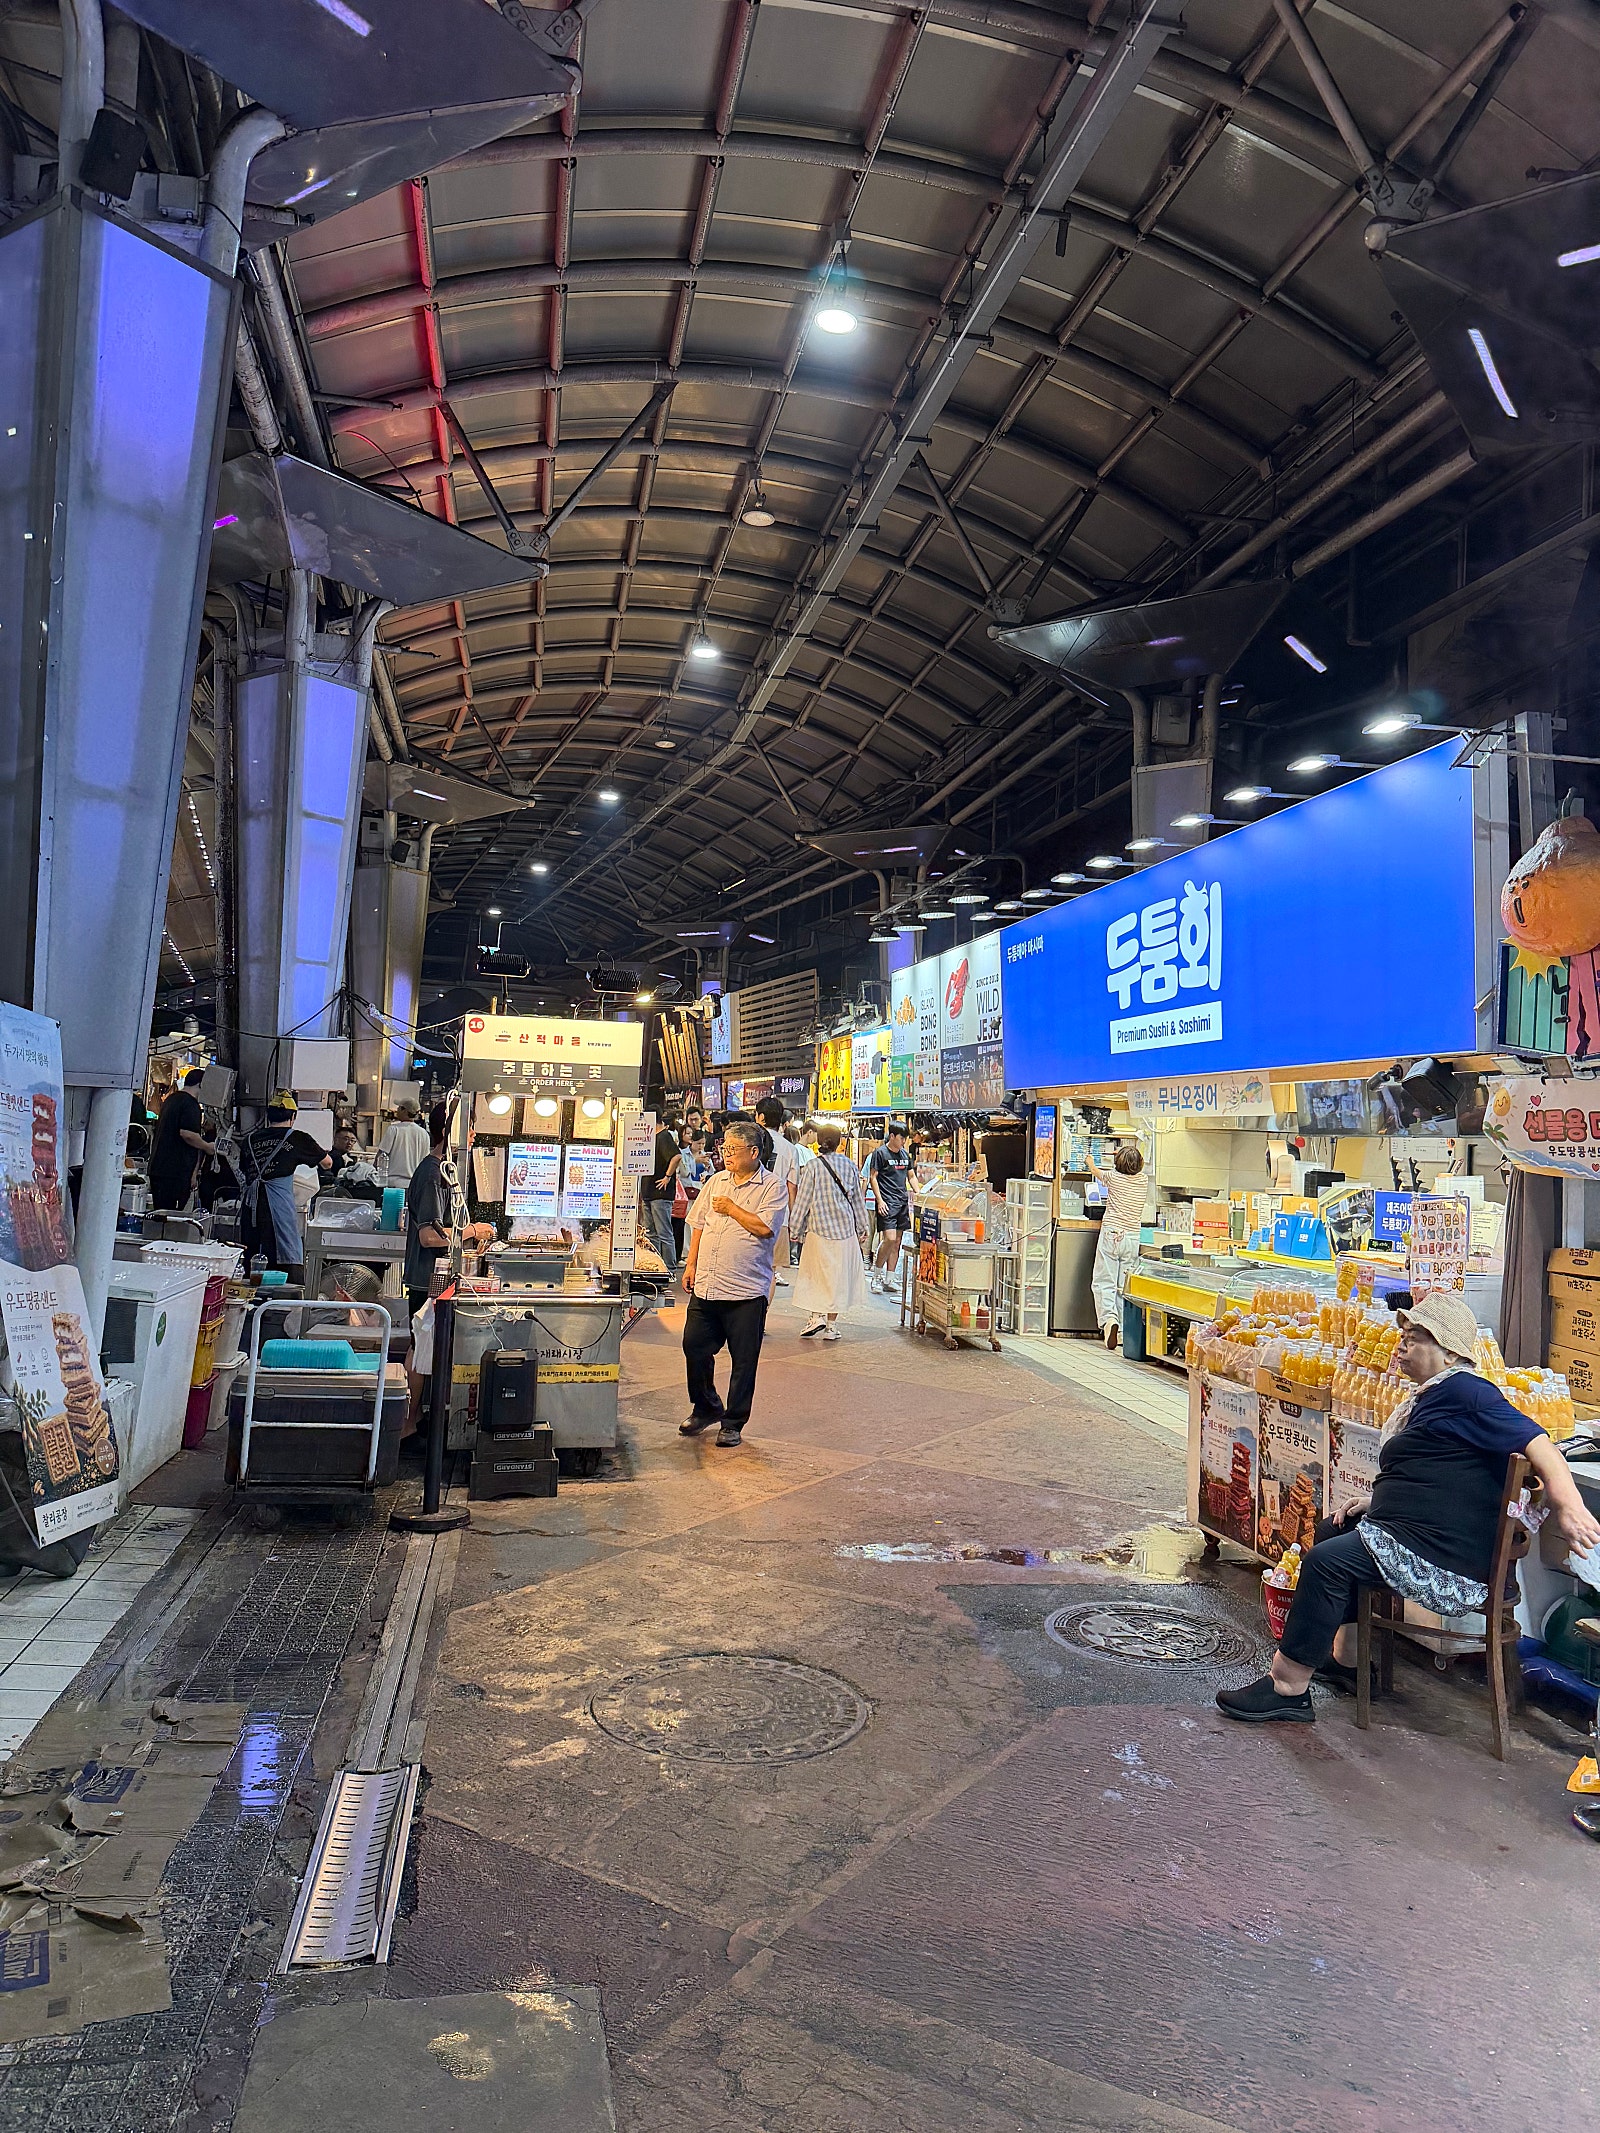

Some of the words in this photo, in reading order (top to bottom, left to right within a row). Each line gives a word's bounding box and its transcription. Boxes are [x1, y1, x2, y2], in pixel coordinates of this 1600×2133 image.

[1106, 880, 1222, 1010] 두툼회
[976, 988, 1000, 1016] WILD
[469, 1021, 484, 1030] 16
[920, 1013, 937, 1032] BONG
[1117, 1026, 1148, 1044] Premium
[1148, 1021, 1169, 1039] Sushi
[1170, 1021, 1176, 1036] &
[1178, 1013, 1211, 1034] Sashimi
[920, 1034, 937, 1052] BONG
[502, 1061, 573, 1079] 주문하는
[588, 1065, 602, 1079] 곳
[530, 1078, 554, 1086] ORDER
[1157, 1083, 1218, 1112] 무늬오징어
[1523, 1107, 1587, 1143] 선물용
[526, 1144, 554, 1153] MENU
[582, 1147, 610, 1156] MENU
[6, 1291, 59, 1312] 우도땅콩샌드
[535, 1348, 584, 1360] 재래시장
[496, 1431, 533, 1439] STANDARD
[1268, 1423, 1317, 1455] 우도땅콩샌드
[496, 1463, 533, 1471] STANDARD
[1339, 1470, 1374, 1493] 레드벨벳샌
